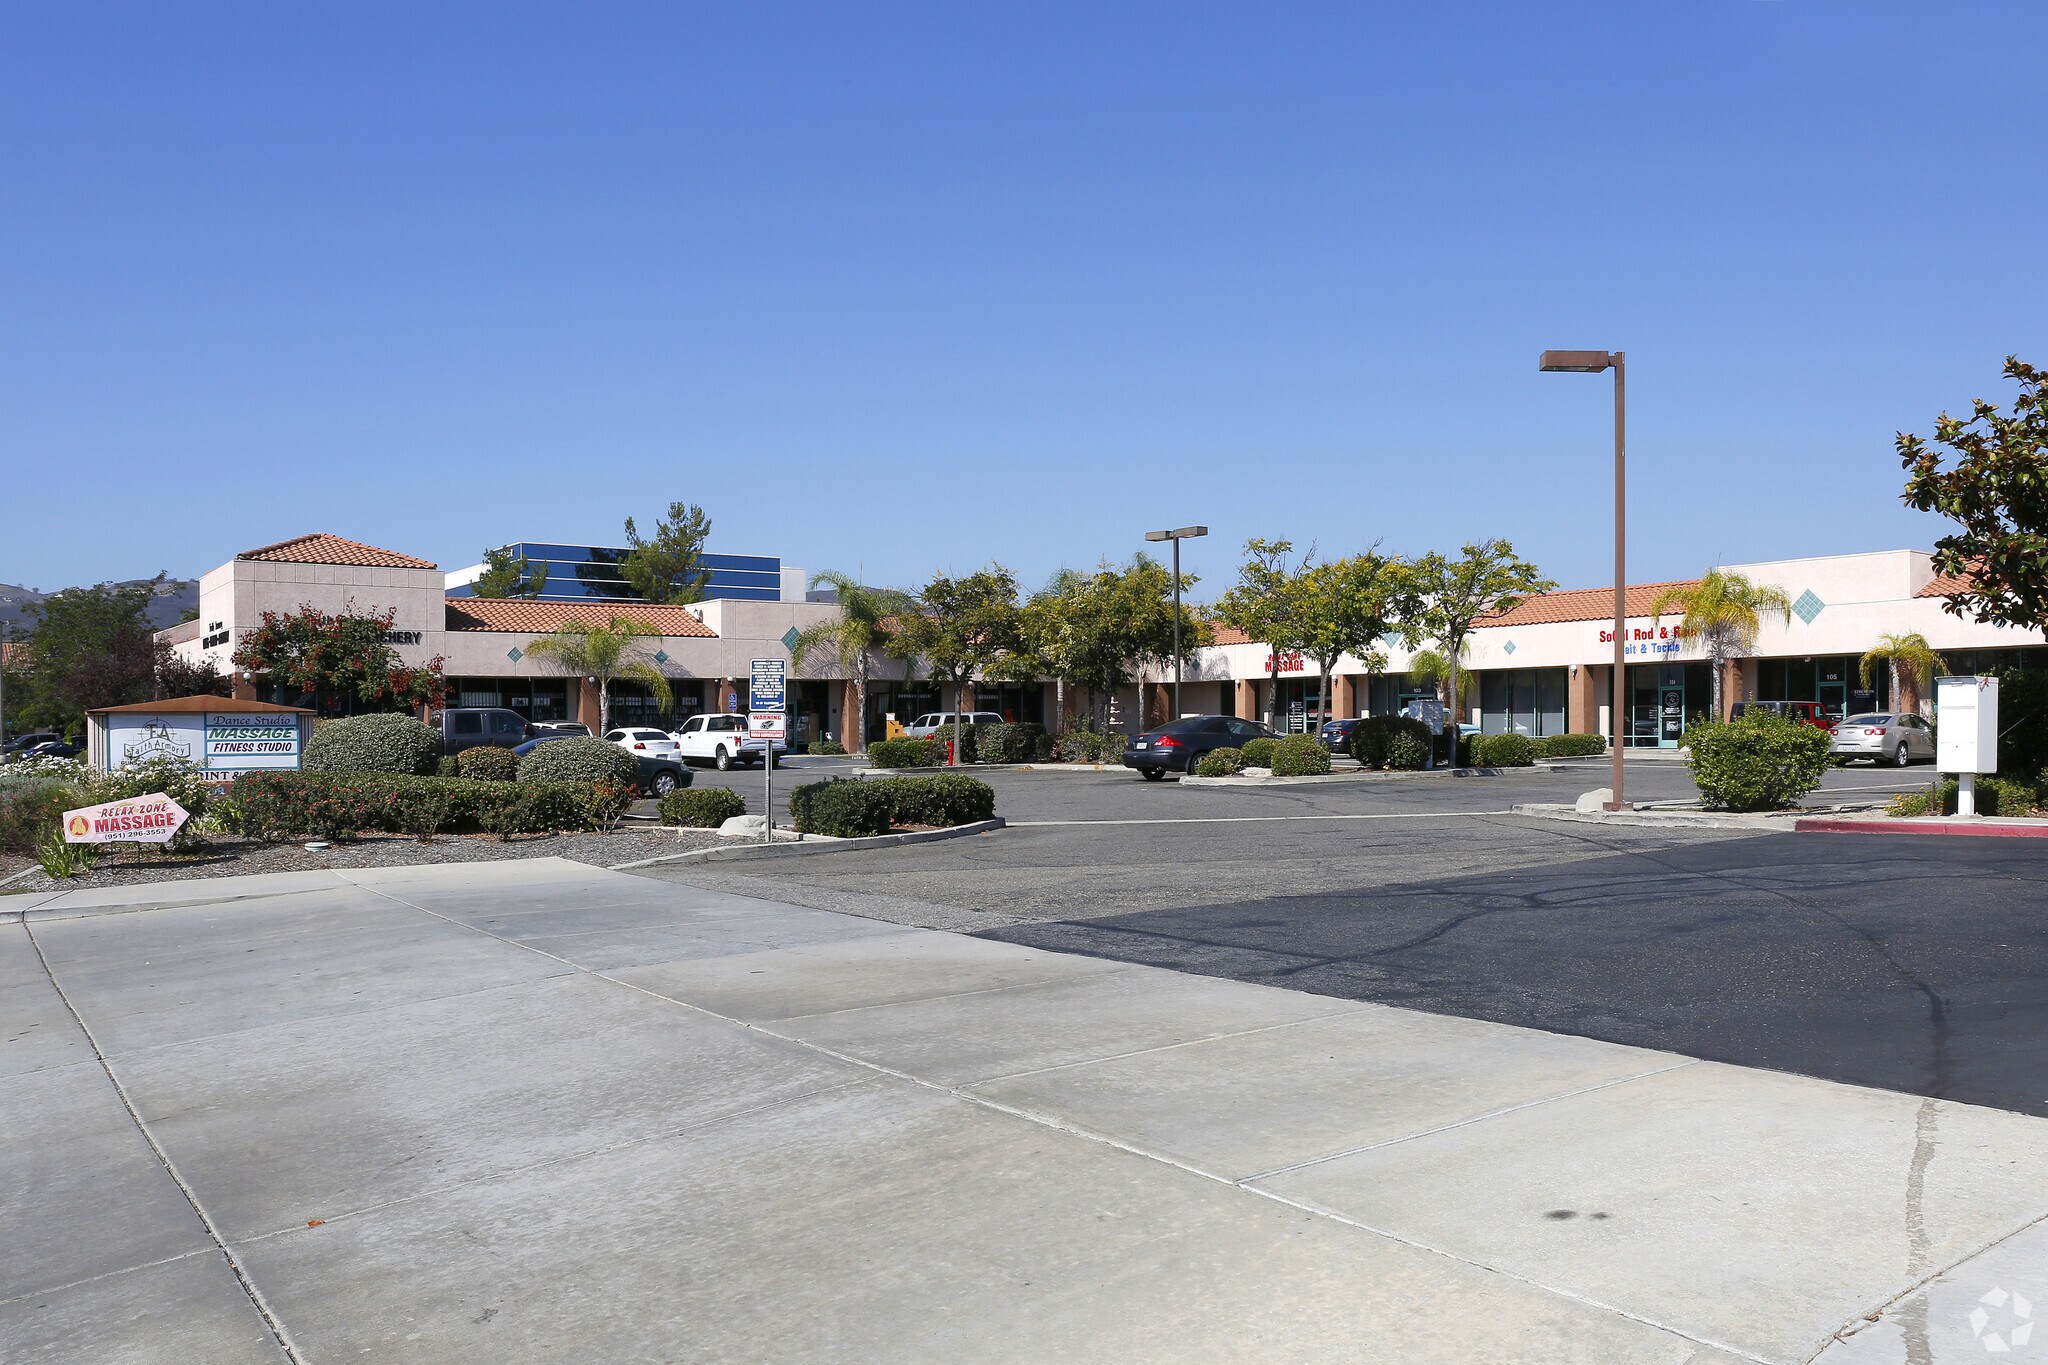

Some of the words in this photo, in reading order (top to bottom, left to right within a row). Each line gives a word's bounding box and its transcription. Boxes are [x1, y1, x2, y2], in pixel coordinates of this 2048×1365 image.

[379, 631, 422, 644] CHERY
[1600, 630, 1628, 642] Sol
[1634, 628, 1653, 640] Rod
[1660, 627, 1668, 639] &
[1624, 644, 1636, 655] ait
[1641, 644, 1647, 653] &
[1652, 642, 1680, 653] Tackle
[1265, 660, 1304, 672] MSSAGE
[213, 715, 250, 725] Dance
[254, 714, 291, 725] Studio
[209, 727, 295, 739] MASSAGE
[154, 740, 185, 756] Armory
[213, 742, 254, 752] FITNESS
[257, 742, 292, 752] STUDIO
[101, 805, 135, 818] RELAX
[139, 802, 168, 814] ZONE
[94, 812, 176, 834] MASSAGE
[128, 828, 166, 838] 296-3553
